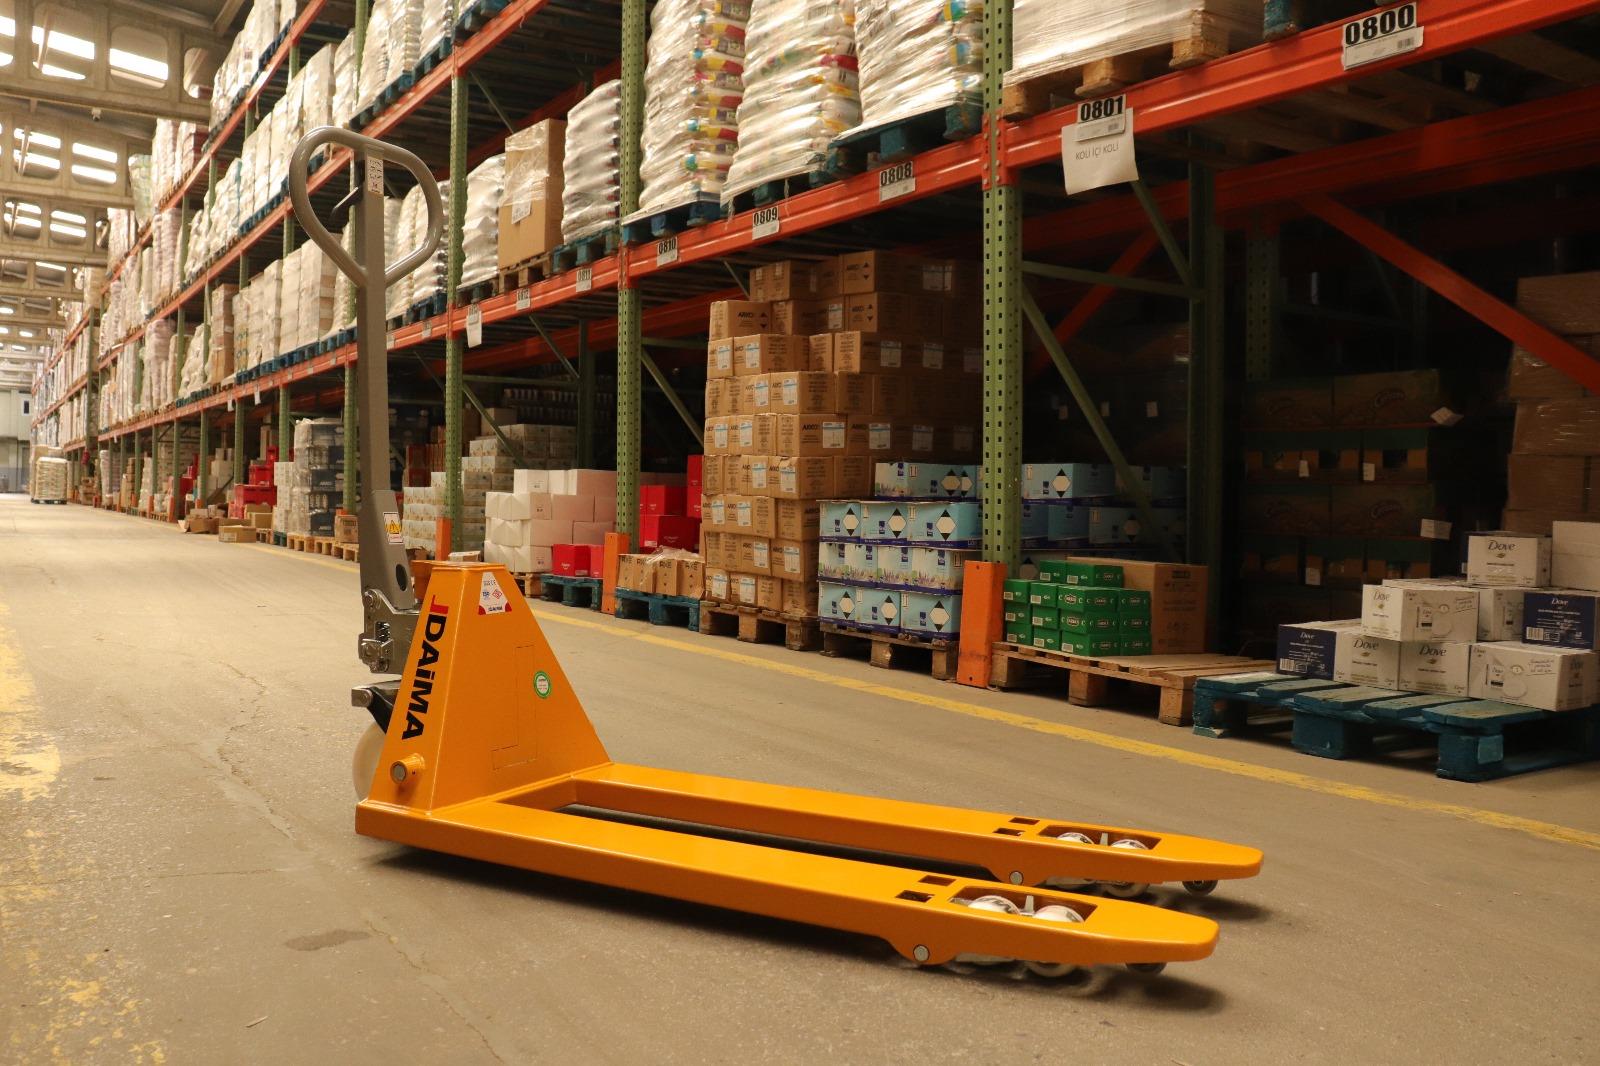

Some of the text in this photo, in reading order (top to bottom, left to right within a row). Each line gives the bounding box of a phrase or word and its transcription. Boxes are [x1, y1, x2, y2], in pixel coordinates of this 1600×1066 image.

[1345, 4, 1415, 45] 0800
[1080, 95, 1123, 121] 0801
[880, 162, 912, 187] 0808
[753, 207, 778, 226] 0809
[658, 238, 676, 254] 0810
[1488, 540, 1516, 551] Dove
[1353, 639, 1380, 651] Dove
[1419, 644, 1447, 657] Dove
